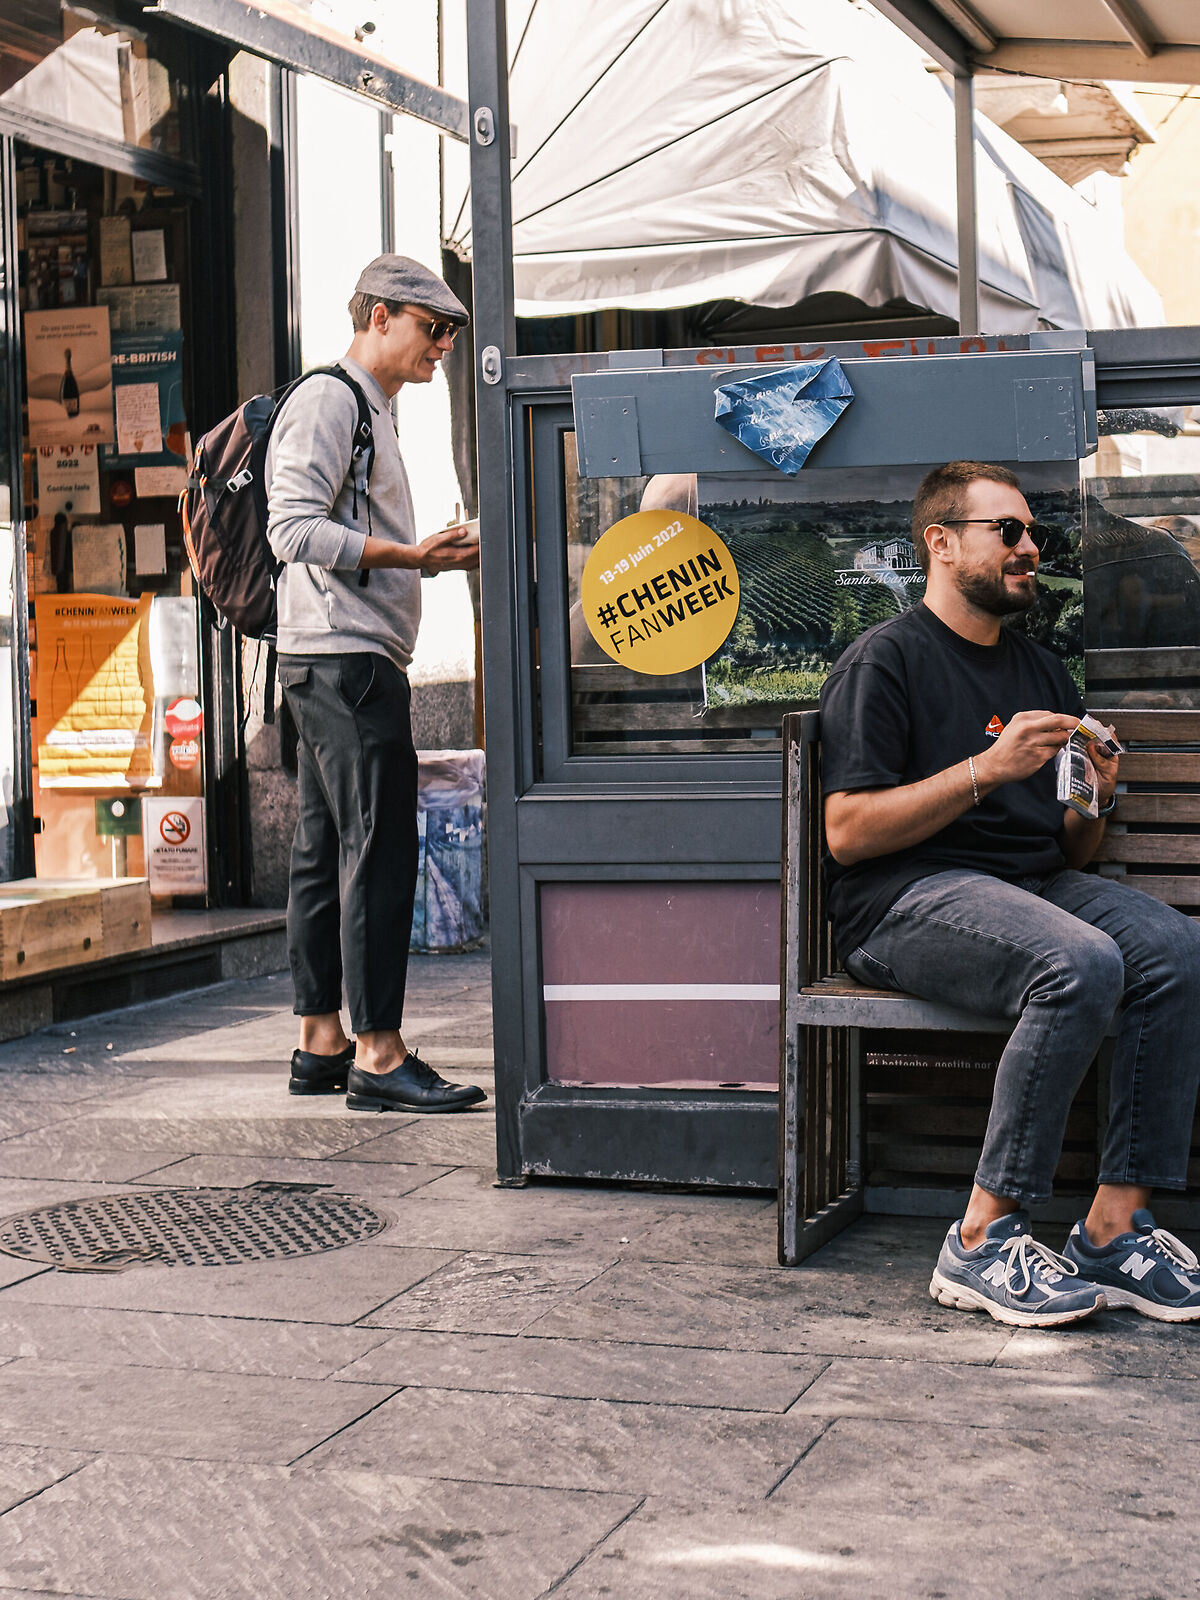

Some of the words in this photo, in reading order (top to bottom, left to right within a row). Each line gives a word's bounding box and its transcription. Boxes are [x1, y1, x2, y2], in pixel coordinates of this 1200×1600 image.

[56, 459, 79, 468] 2022
[599, 560, 630, 585] 13-19
[628, 543, 655, 568] juin
[652, 520, 684, 548] 2022
[835, 572, 871, 586] Santa
[871, 571, 927, 588] Margher
[597, 548, 722, 629] #CHENIN
[610, 575, 735, 654] FANWEEK
